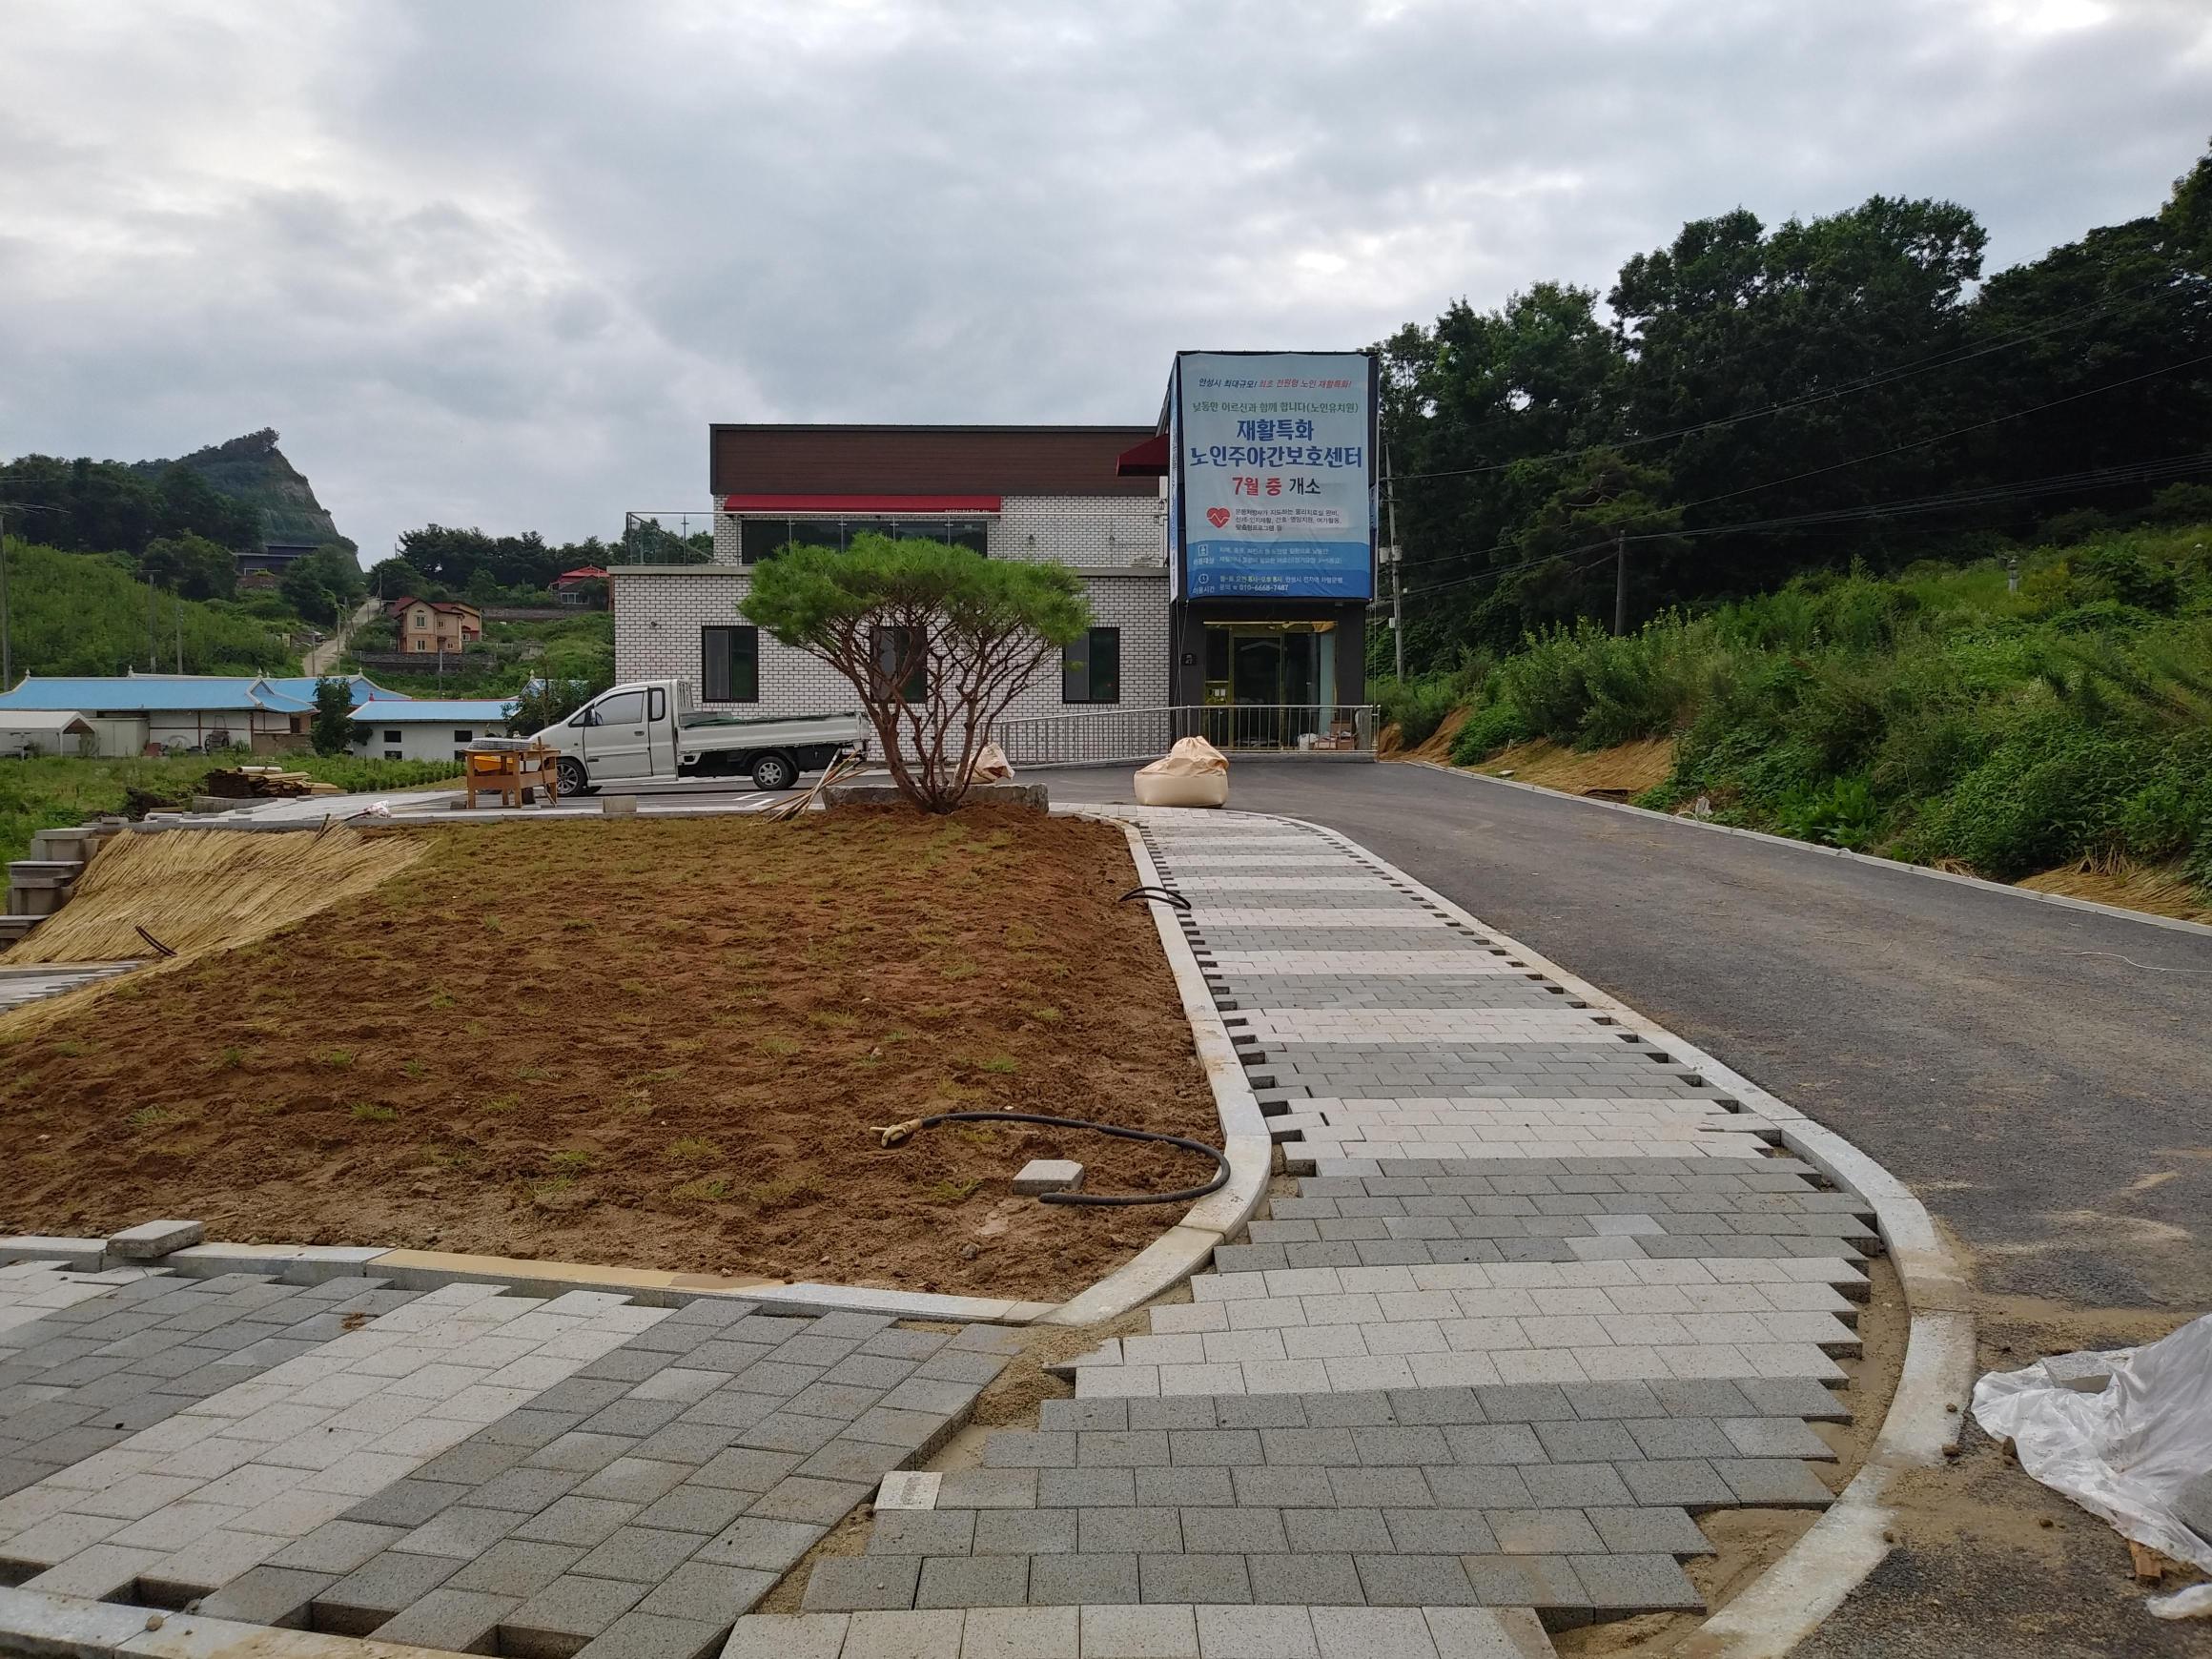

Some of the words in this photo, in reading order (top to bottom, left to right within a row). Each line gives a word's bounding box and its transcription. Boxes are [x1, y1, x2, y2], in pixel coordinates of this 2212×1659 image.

[1198, 378, 1221, 388] 안성시
[1223, 379, 1258, 389] 최대규모!
[1301, 379, 1317, 389] 노인
[1220, 401, 1257, 413] 어르신과
[1260, 402, 1278, 413] 함께
[1236, 419, 1315, 441] 재활특화
[1189, 444, 1363, 468] 노인주야간보호센터
[1232, 477, 1260, 496] 7월
[1264, 477, 1282, 496] 중
[1288, 477, 1321, 496] 개소
